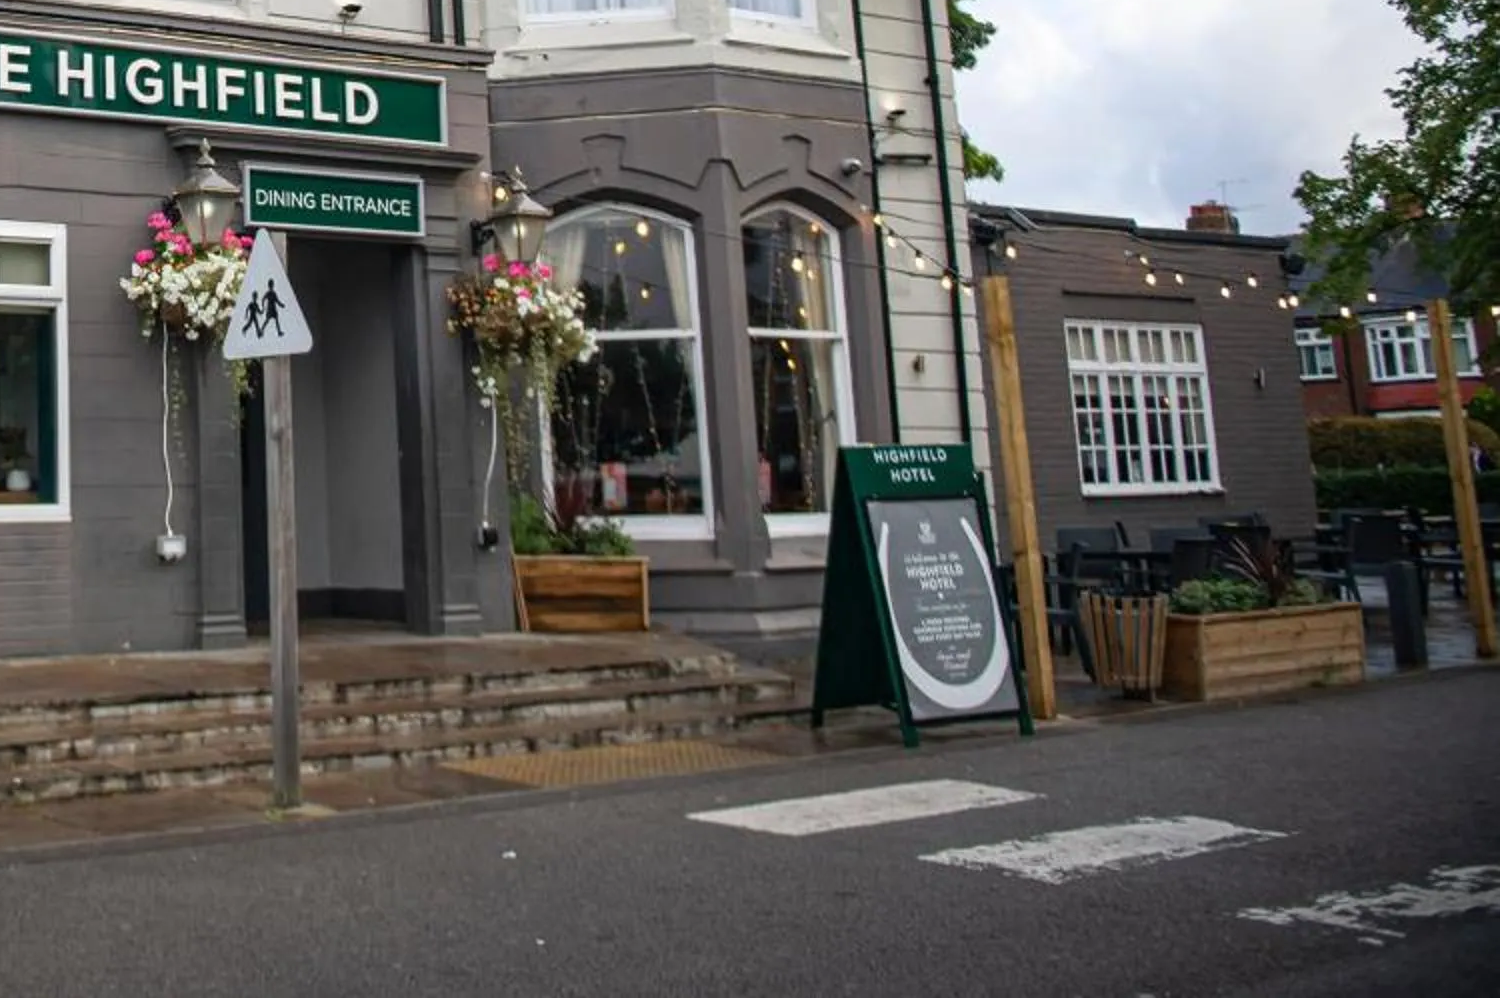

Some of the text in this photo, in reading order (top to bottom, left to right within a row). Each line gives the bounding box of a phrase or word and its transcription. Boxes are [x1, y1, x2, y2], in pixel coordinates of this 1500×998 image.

[57, 49, 379, 125] HIGHFIELD
[255, 188, 412, 217] DINING ENTRANCE
[873, 448, 947, 463] HIGHFIELD
[890, 467, 936, 483] HOTEL
[906, 563, 964, 579] HIGHFIELD
[920, 578, 957, 591] HOTEL
